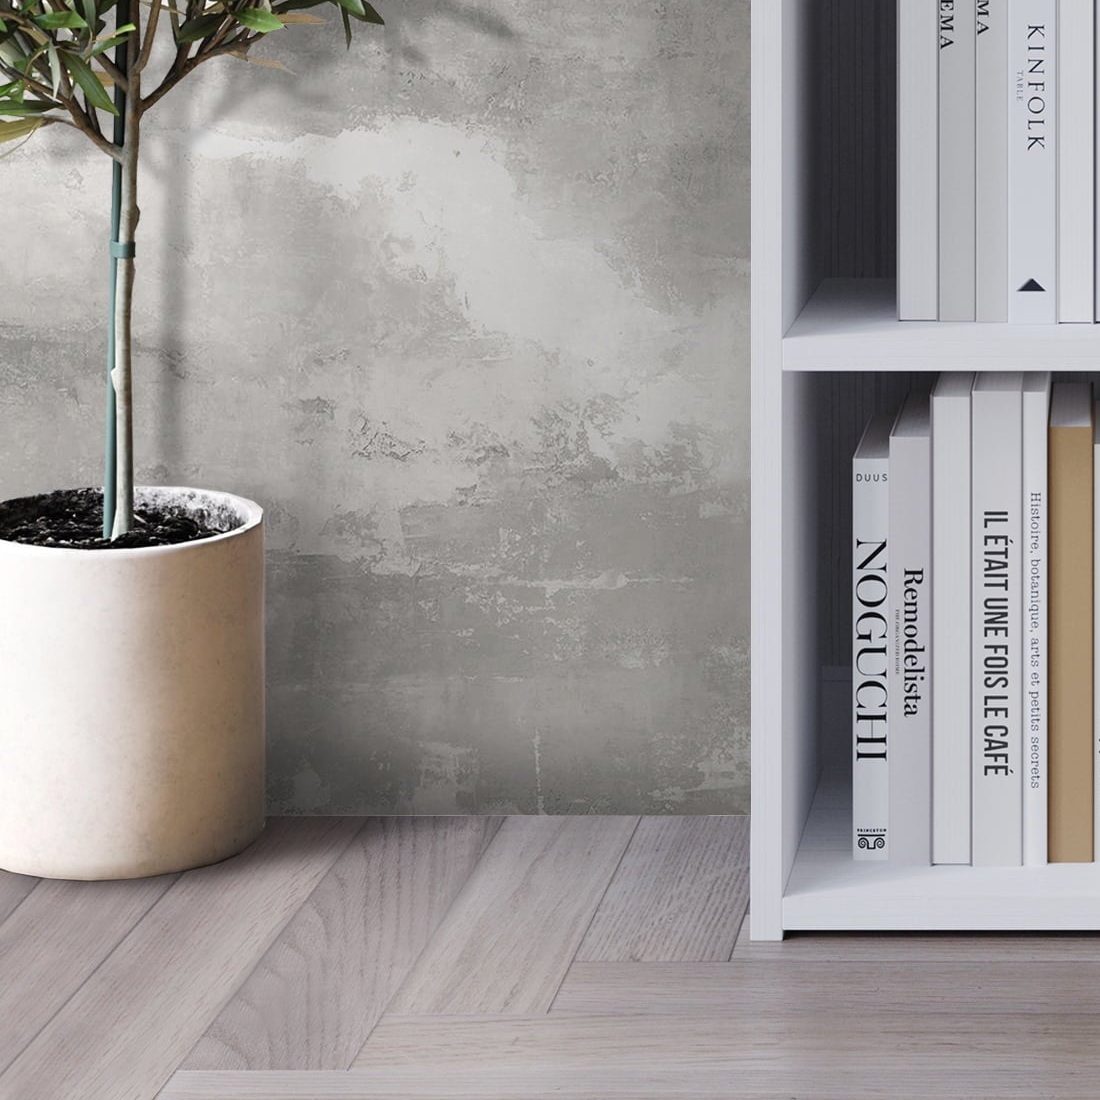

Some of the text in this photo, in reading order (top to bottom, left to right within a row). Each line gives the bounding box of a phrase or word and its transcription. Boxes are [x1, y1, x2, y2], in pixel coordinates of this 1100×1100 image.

[1016, 70, 1024, 101] TABLE
[1027, 24, 1045, 151] KINFOLK
[856, 473, 887, 482] DUUS
[855, 538, 888, 762] NOGUCHI
[903, 568, 925, 717] Remodelista
[984, 510, 1014, 776] IL ÉTAIT UNE FOIS LE CAFÉ
[1028, 492, 1042, 789] Histoire, botanique, arts et petits secrets
